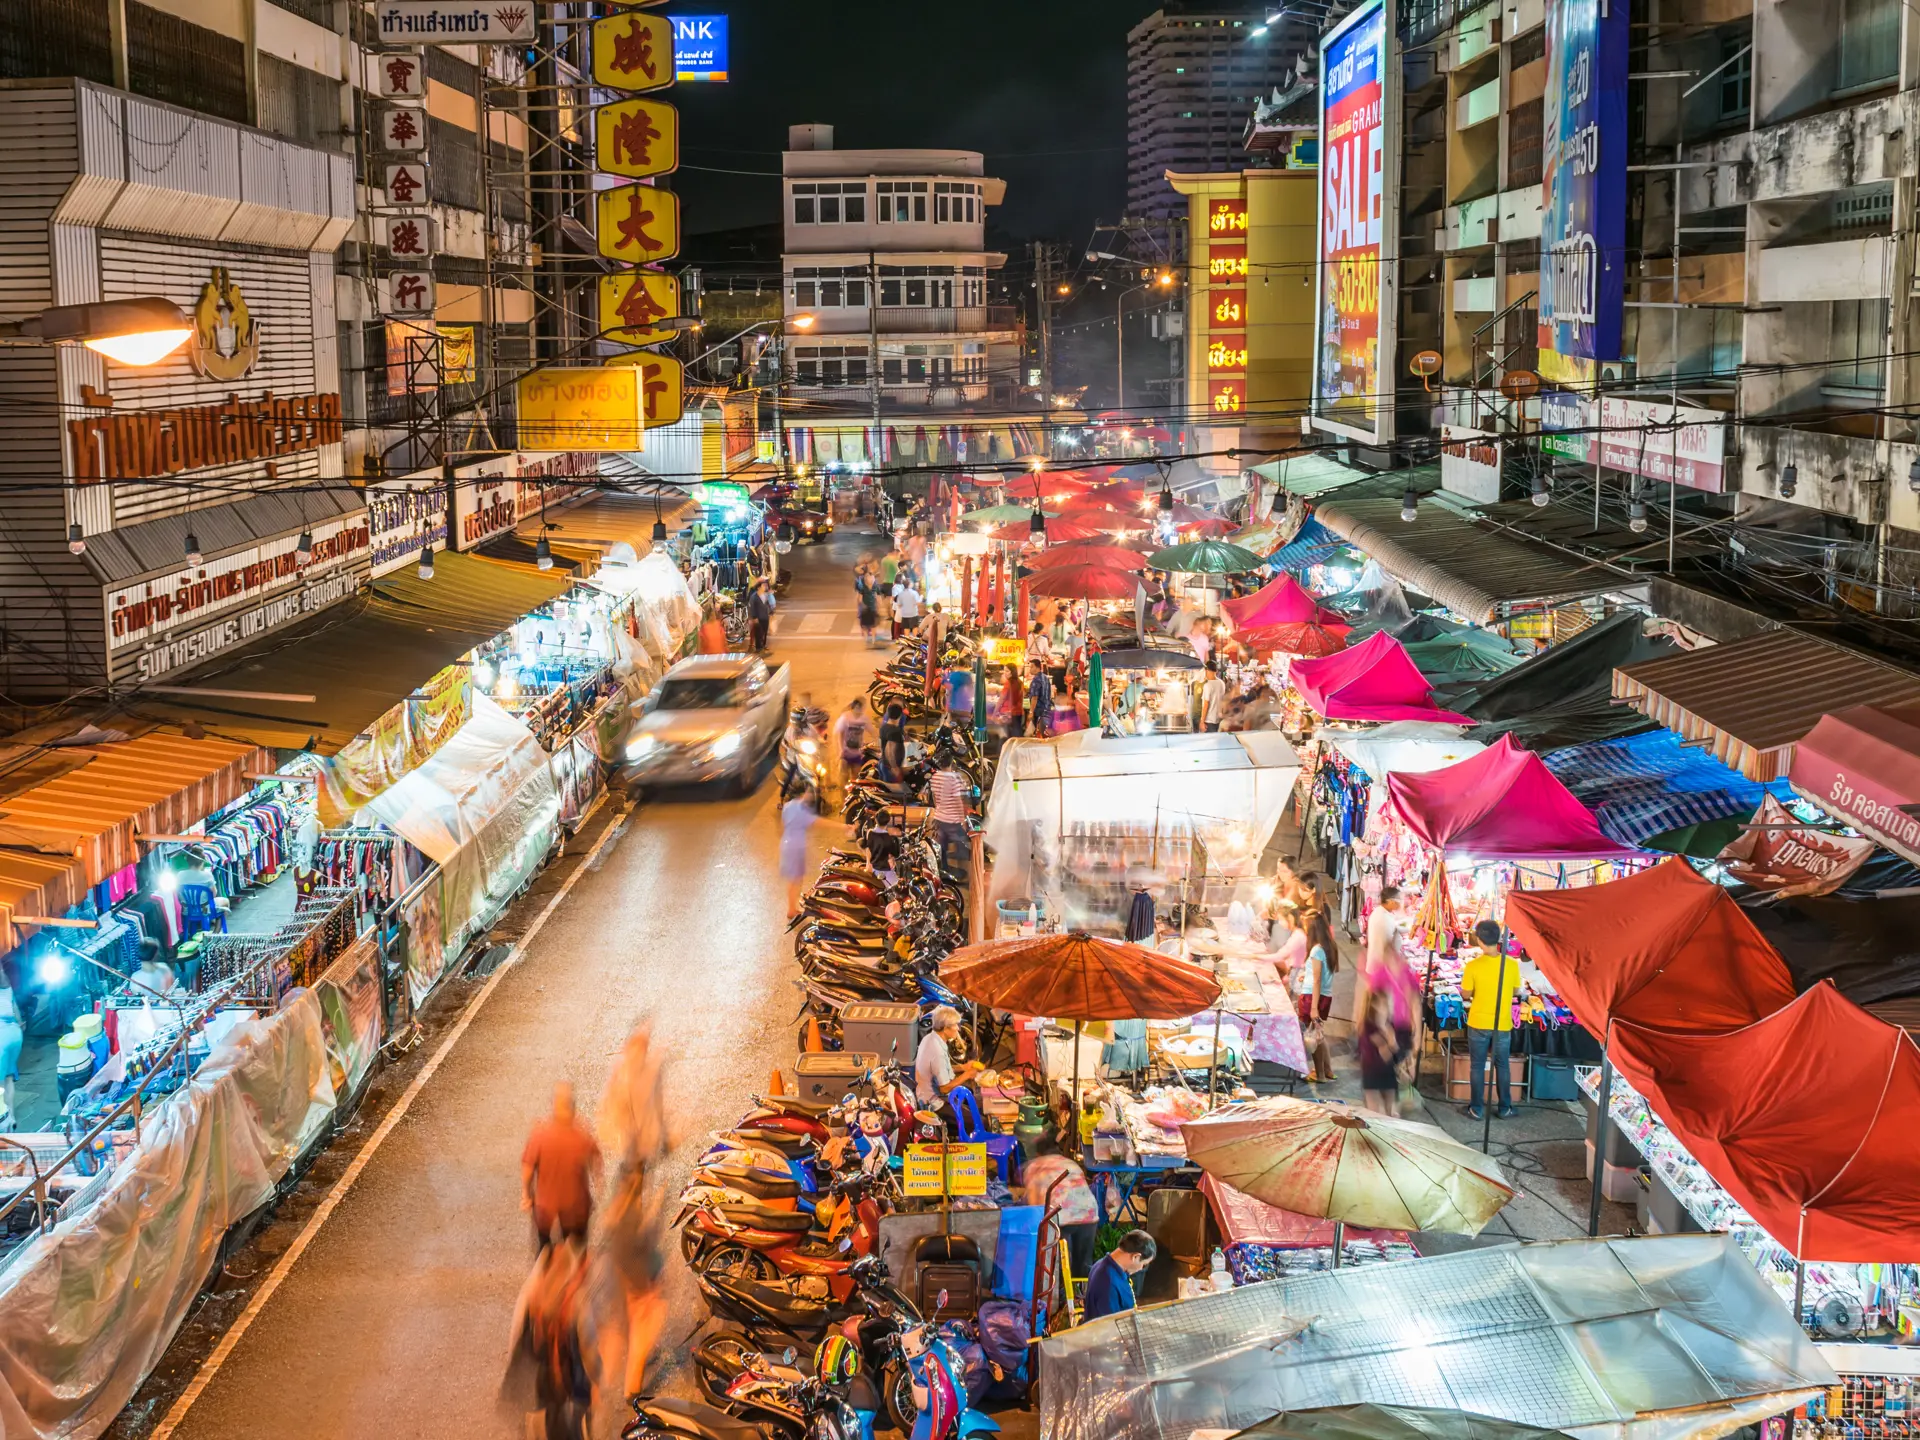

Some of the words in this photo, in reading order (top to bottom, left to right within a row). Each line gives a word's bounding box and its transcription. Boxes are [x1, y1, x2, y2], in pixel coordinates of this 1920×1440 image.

[674, 21, 713, 39] NK
[1326, 126, 1382, 254] SALE
[1340, 252, 1378, 313] 30-80
[528, 376, 628, 402] ห้างทอง
[67, 384, 342, 486] ห้างทองแสงสุวรรณ
